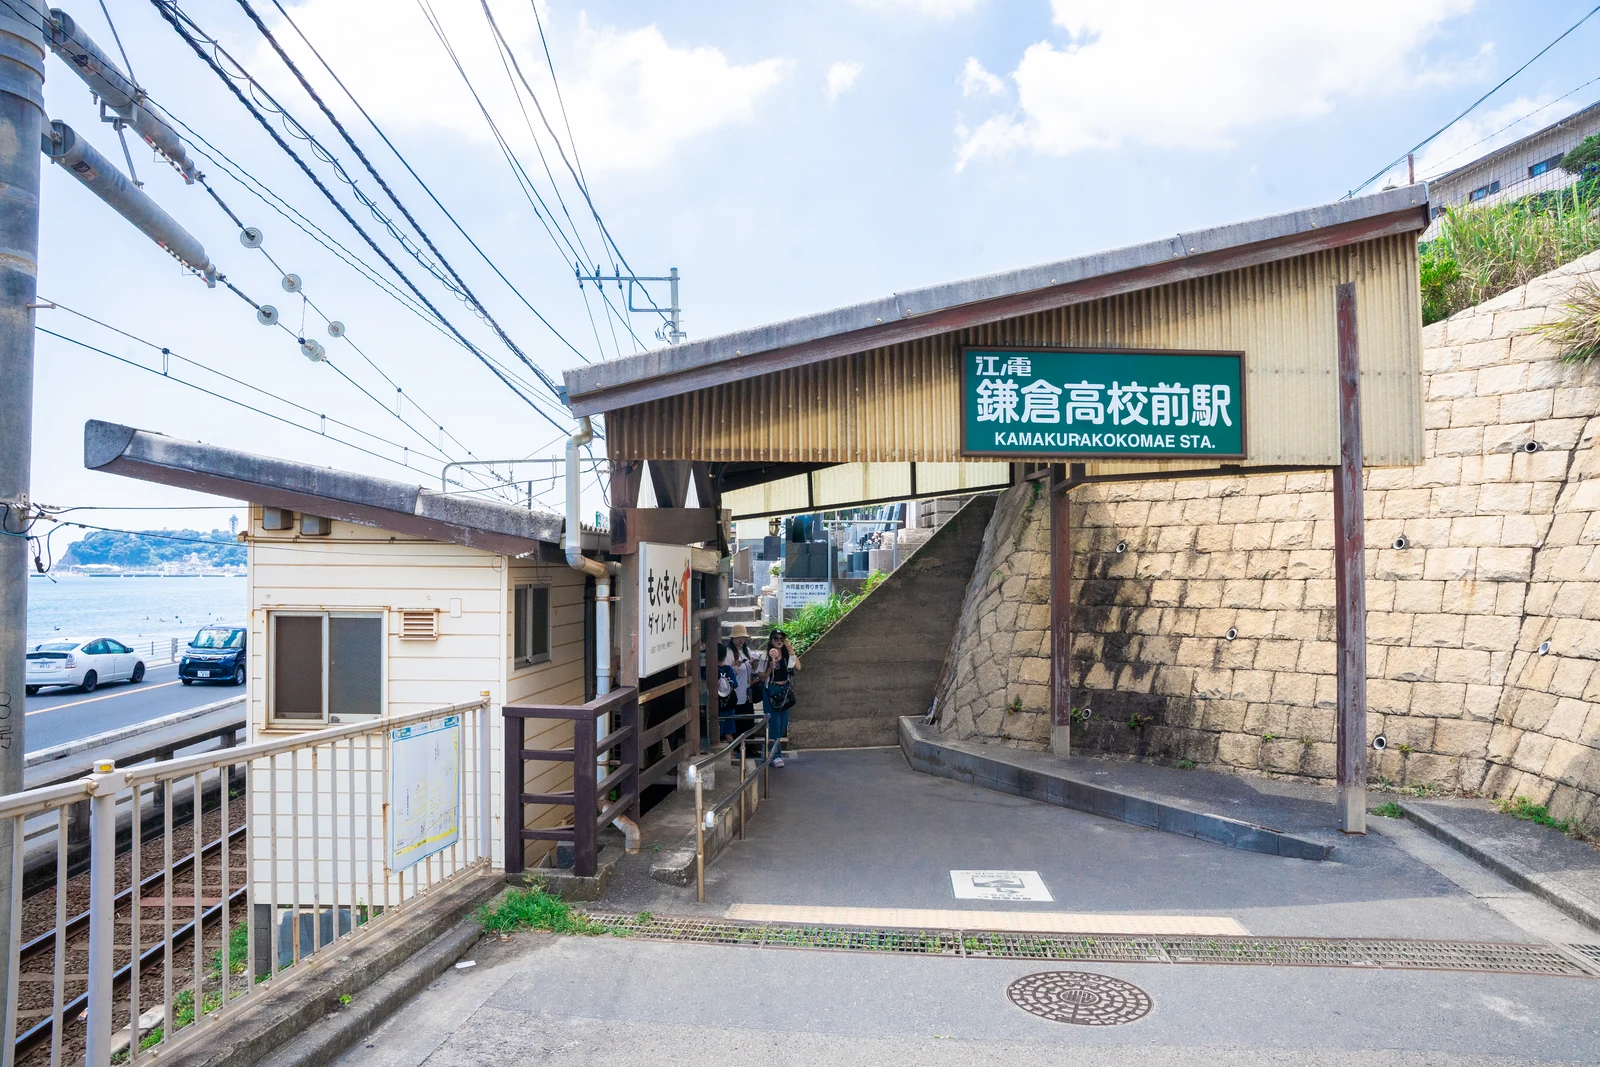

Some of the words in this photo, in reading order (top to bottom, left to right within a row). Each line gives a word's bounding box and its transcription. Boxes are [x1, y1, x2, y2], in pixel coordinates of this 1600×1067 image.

[976, 355, 1031, 376] 江ノ電
[976, 378, 1232, 427] 鎌倉高校前駅
[996, 432, 1175, 447] KAMAKURAKOKOMAE
[1180, 434, 1216, 449] STA.
[648, 568, 678, 607] もぐもぐ
[648, 610, 677, 636] ダイレクト
